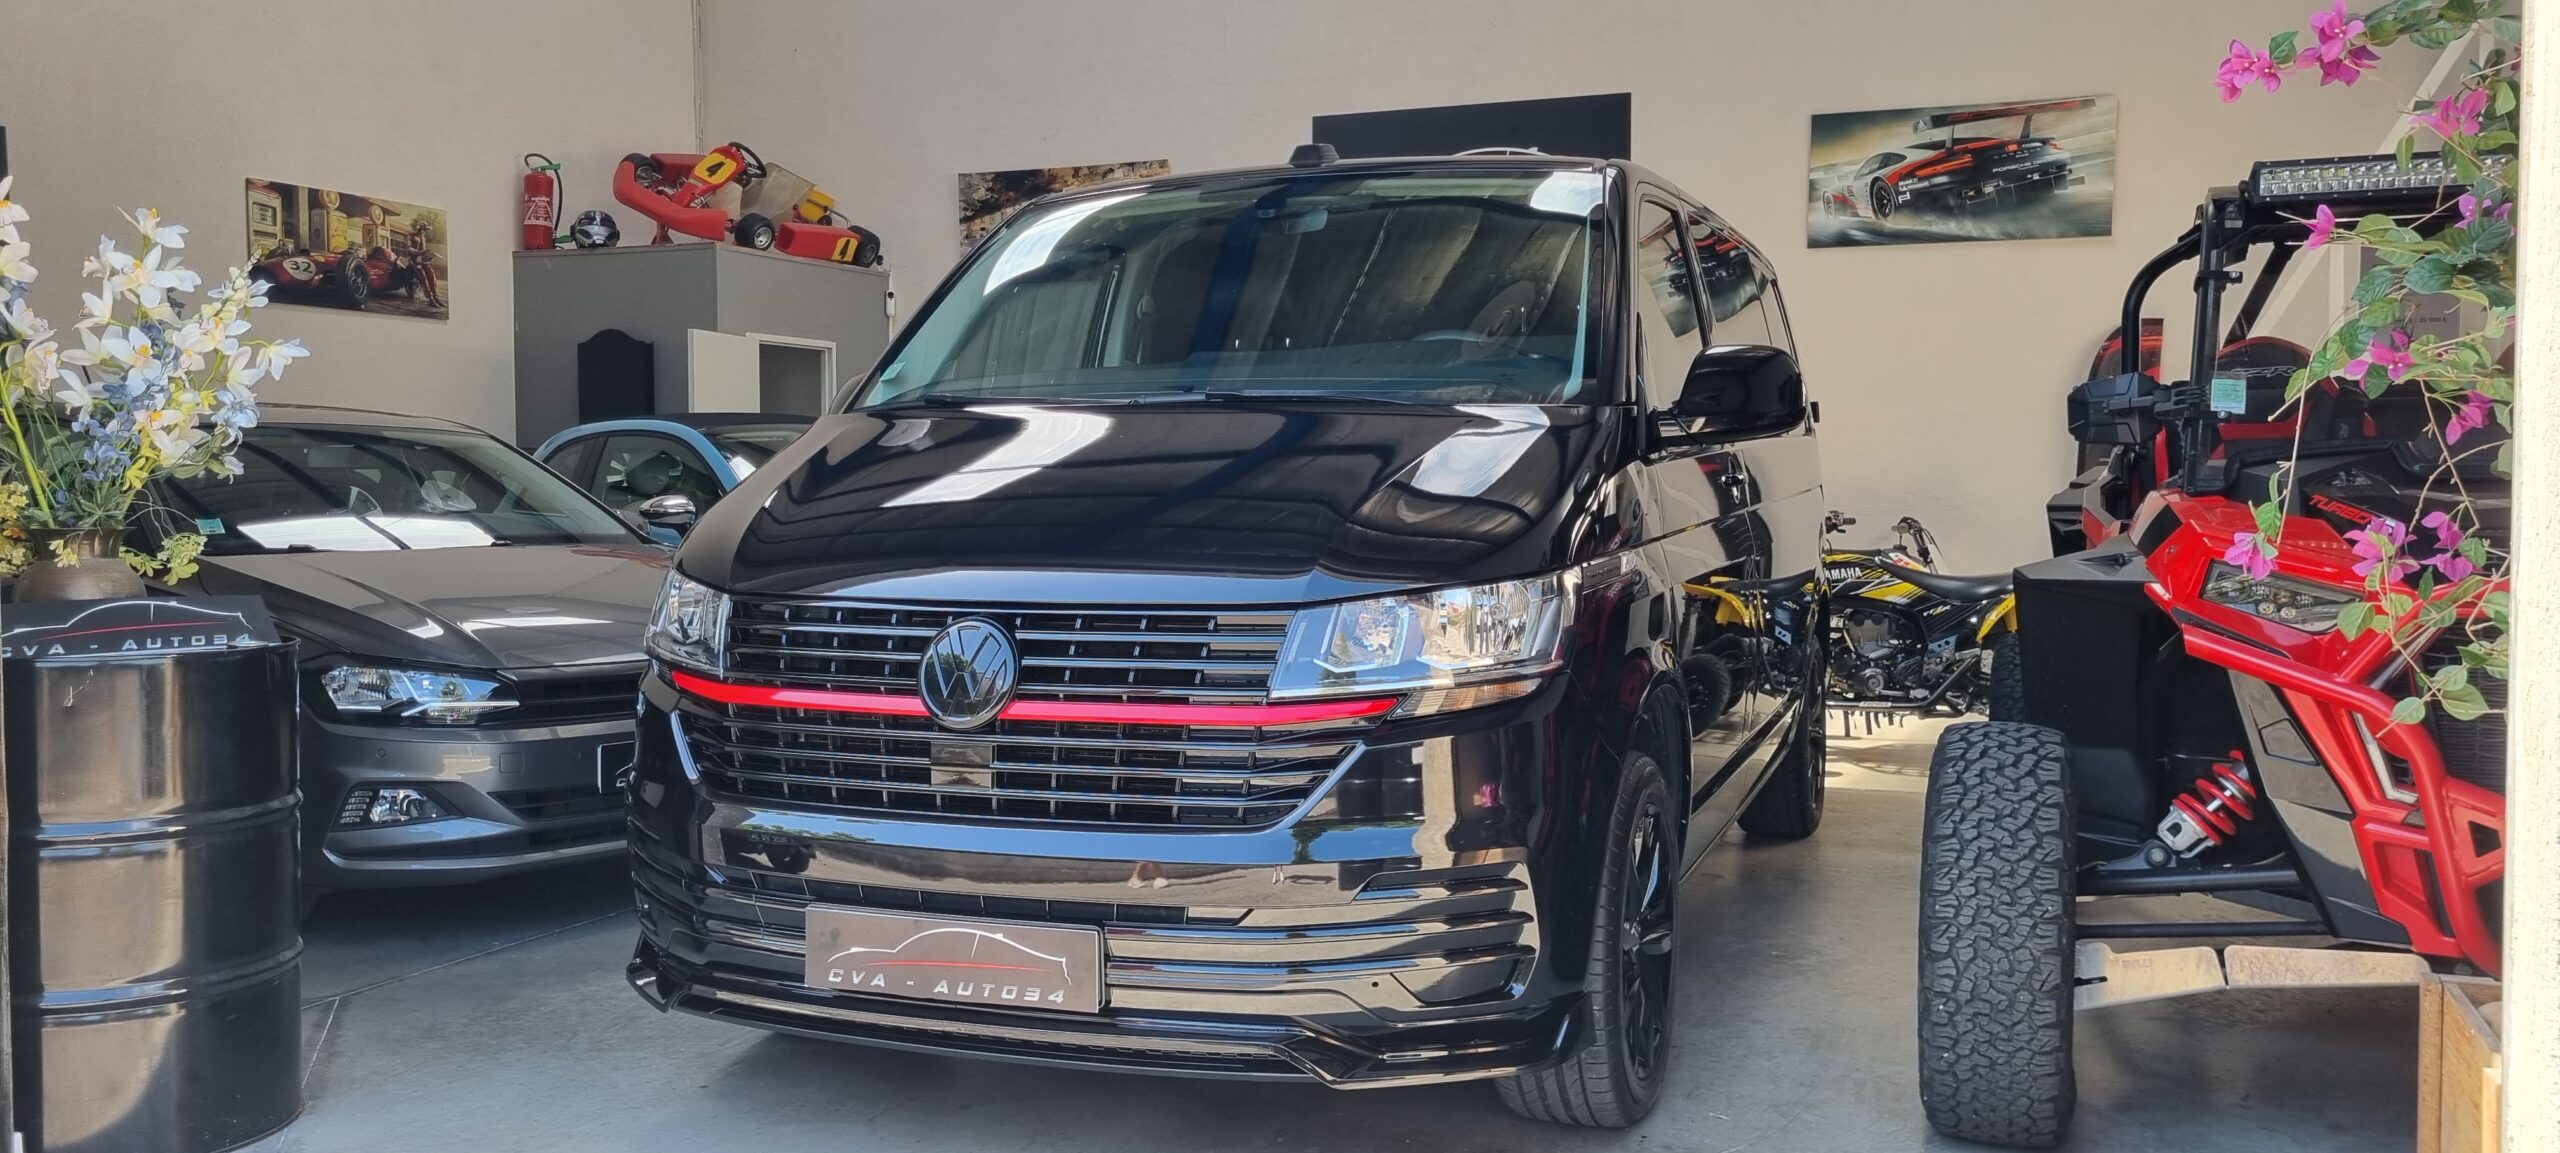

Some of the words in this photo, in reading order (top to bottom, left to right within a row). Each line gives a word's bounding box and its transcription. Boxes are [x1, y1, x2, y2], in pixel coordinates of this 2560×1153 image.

[705, 161, 726, 178] 4
[839, 239, 851, 260] 4
[289, 260, 313, 275] 32
[2309, 495, 2373, 525] TURBO
[1822, 566, 1863, 580] AMAHA
[2, 644, 66, 658] CVA
[121, 633, 251, 651] AUTO34
[828, 968, 886, 988] CVA
[932, 979, 1065, 1004] AUTO34
